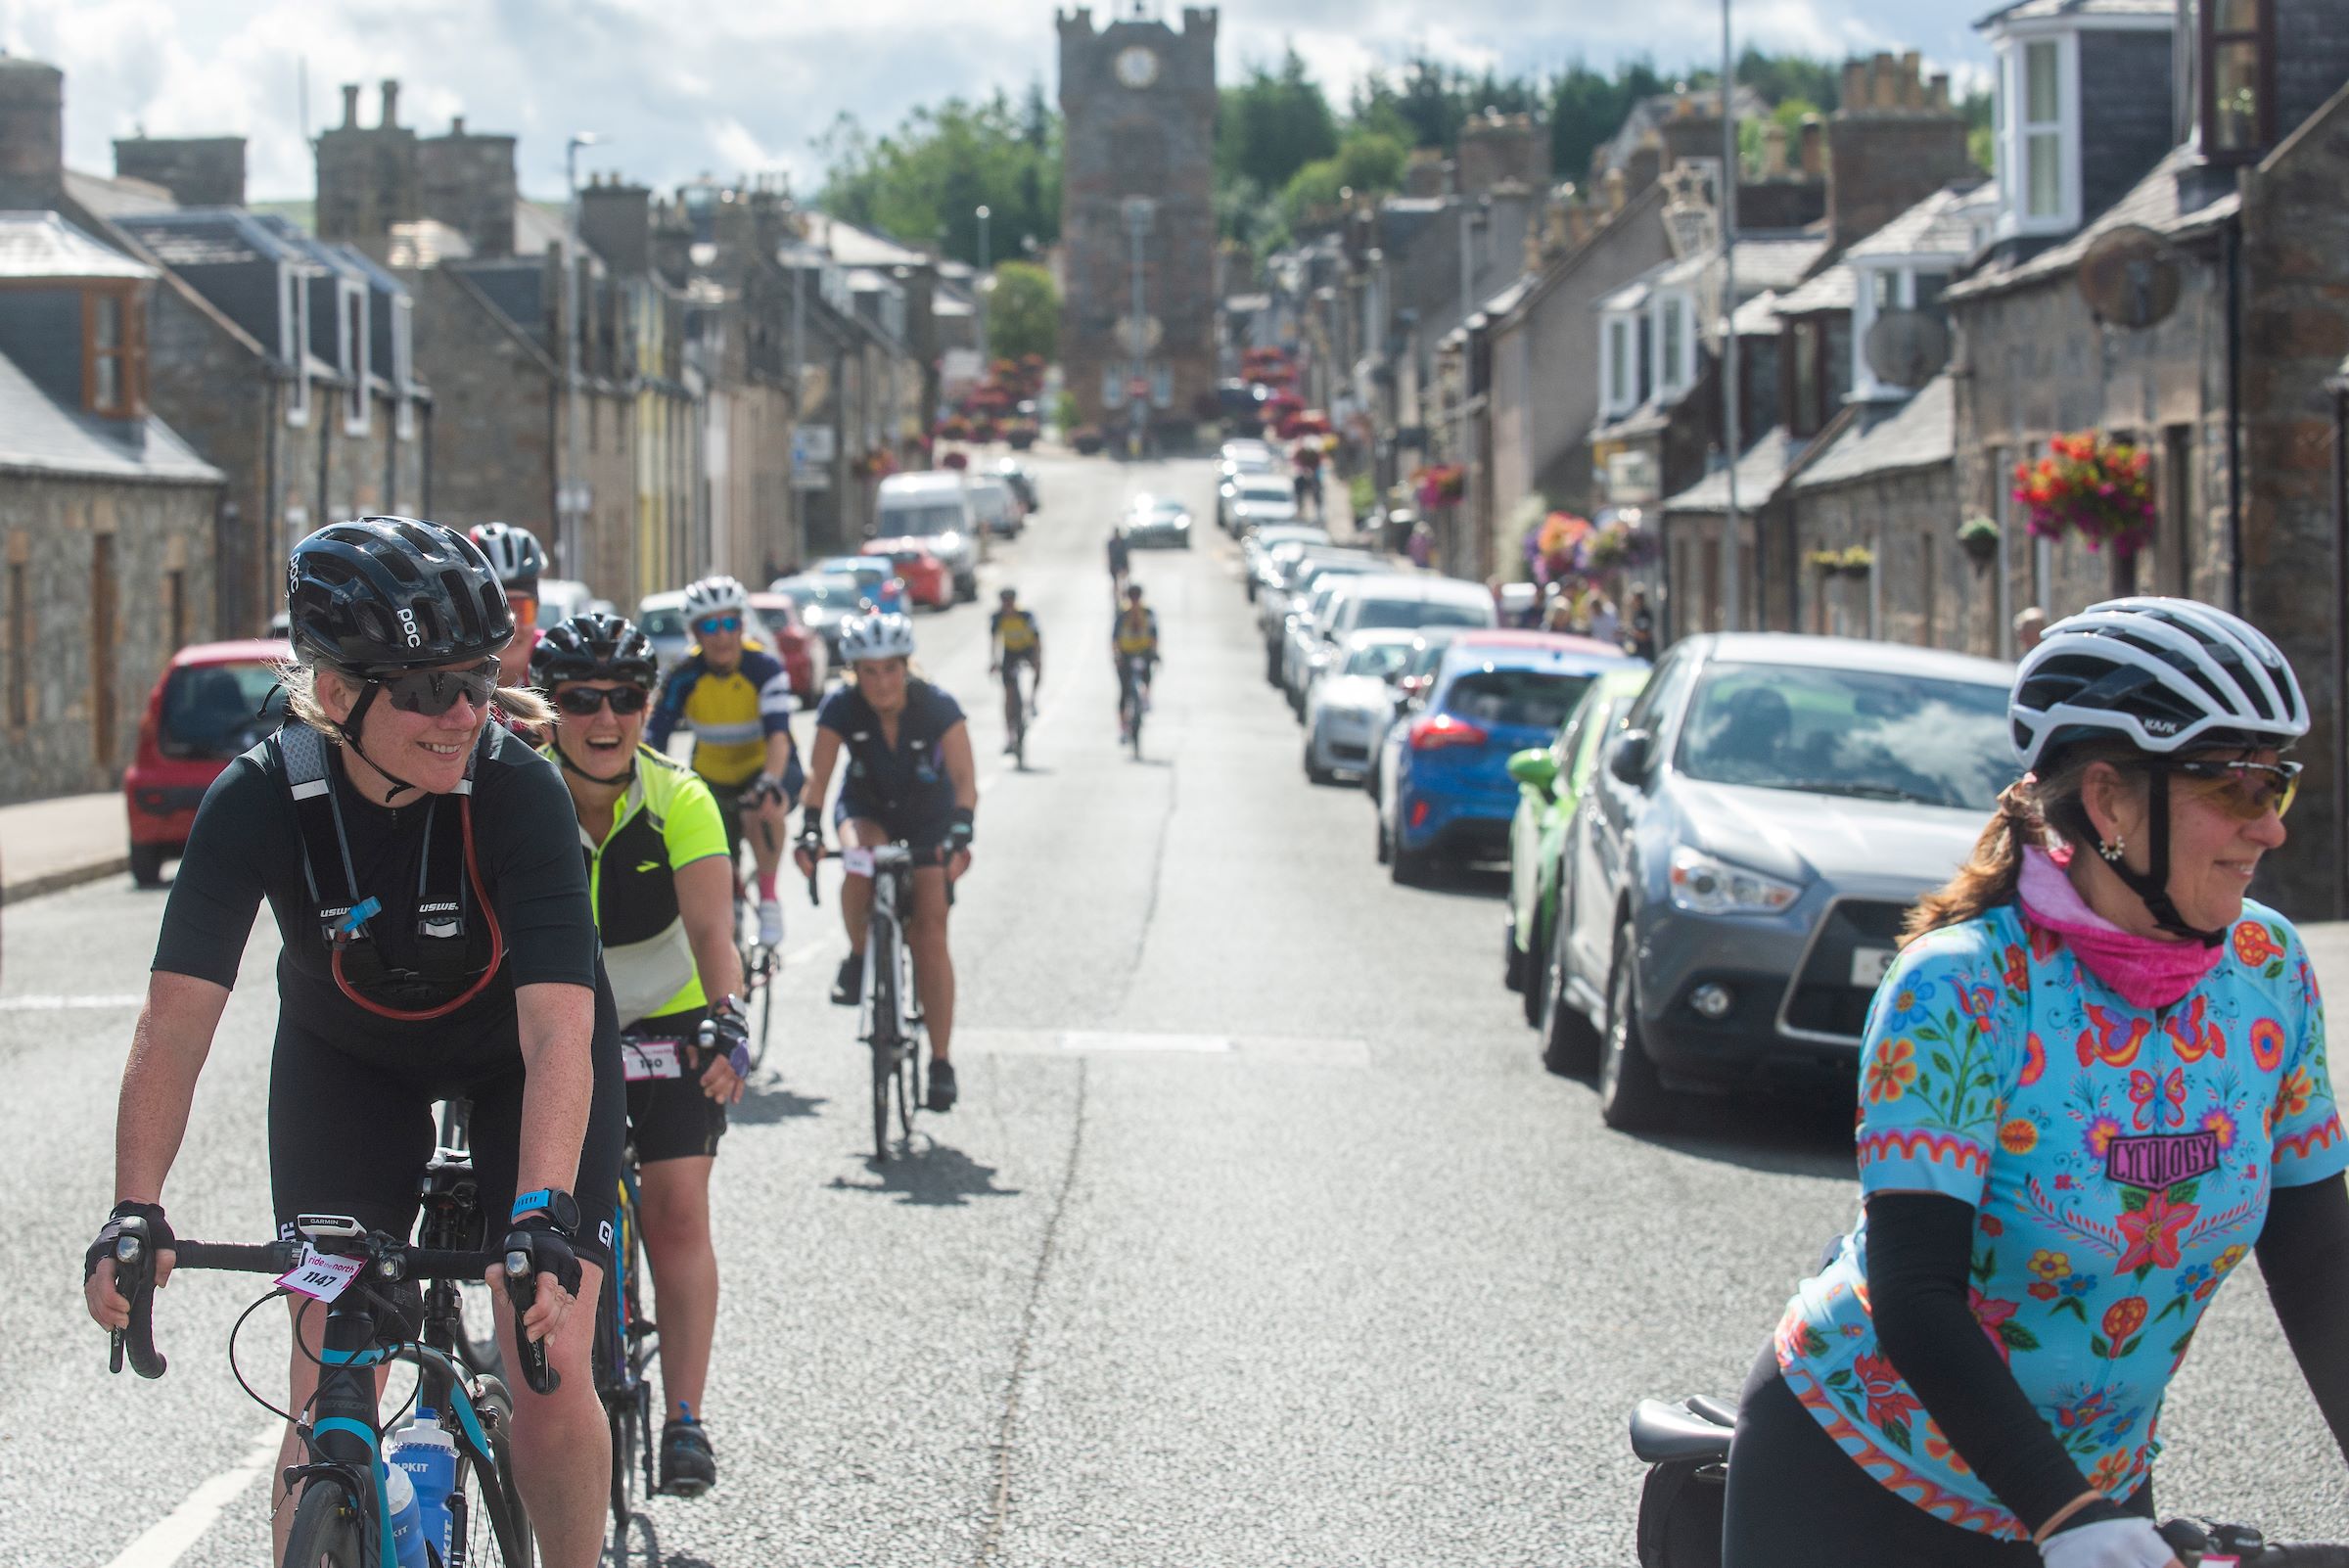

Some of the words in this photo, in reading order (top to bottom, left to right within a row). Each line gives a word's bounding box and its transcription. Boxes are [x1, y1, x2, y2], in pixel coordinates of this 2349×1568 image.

[320, 906, 351, 917] USW
[639, 1058, 663, 1069] 10
[2114, 1137, 2211, 1182] CYCOLOGY
[307, 1255, 324, 1267] ride
[333, 1262, 355, 1273] north
[302, 1271, 337, 1288] 1147
[397, 1462, 429, 1473] PKIT
[393, 1525, 408, 1538] KIT
[442, 1519, 452, 1568] PKIT
